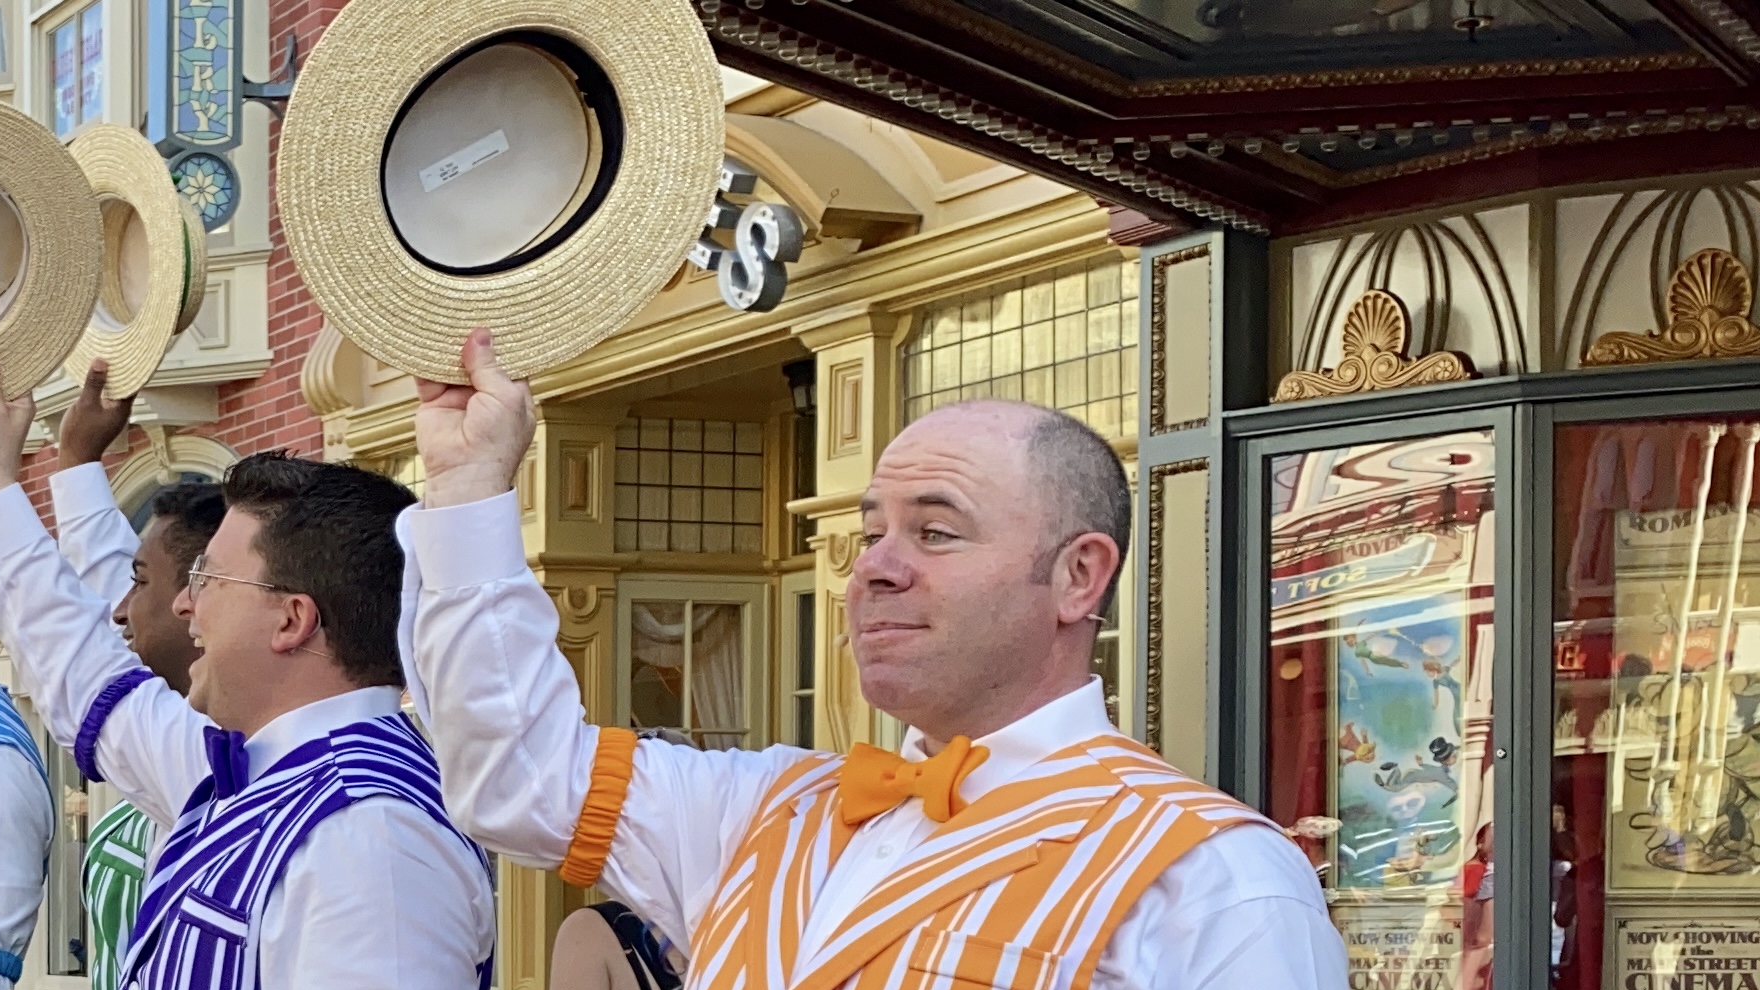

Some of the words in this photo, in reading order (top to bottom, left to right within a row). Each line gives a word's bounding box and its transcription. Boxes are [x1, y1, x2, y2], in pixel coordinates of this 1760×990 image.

[190, 0, 218, 131] LRY
[1385, 932, 1454, 945] SHOING
[1627, 931, 1668, 944] NOW
[1348, 958, 1389, 969] MA
[1627, 958, 1678, 970] MA
[1683, 958, 1760, 970] STREET
